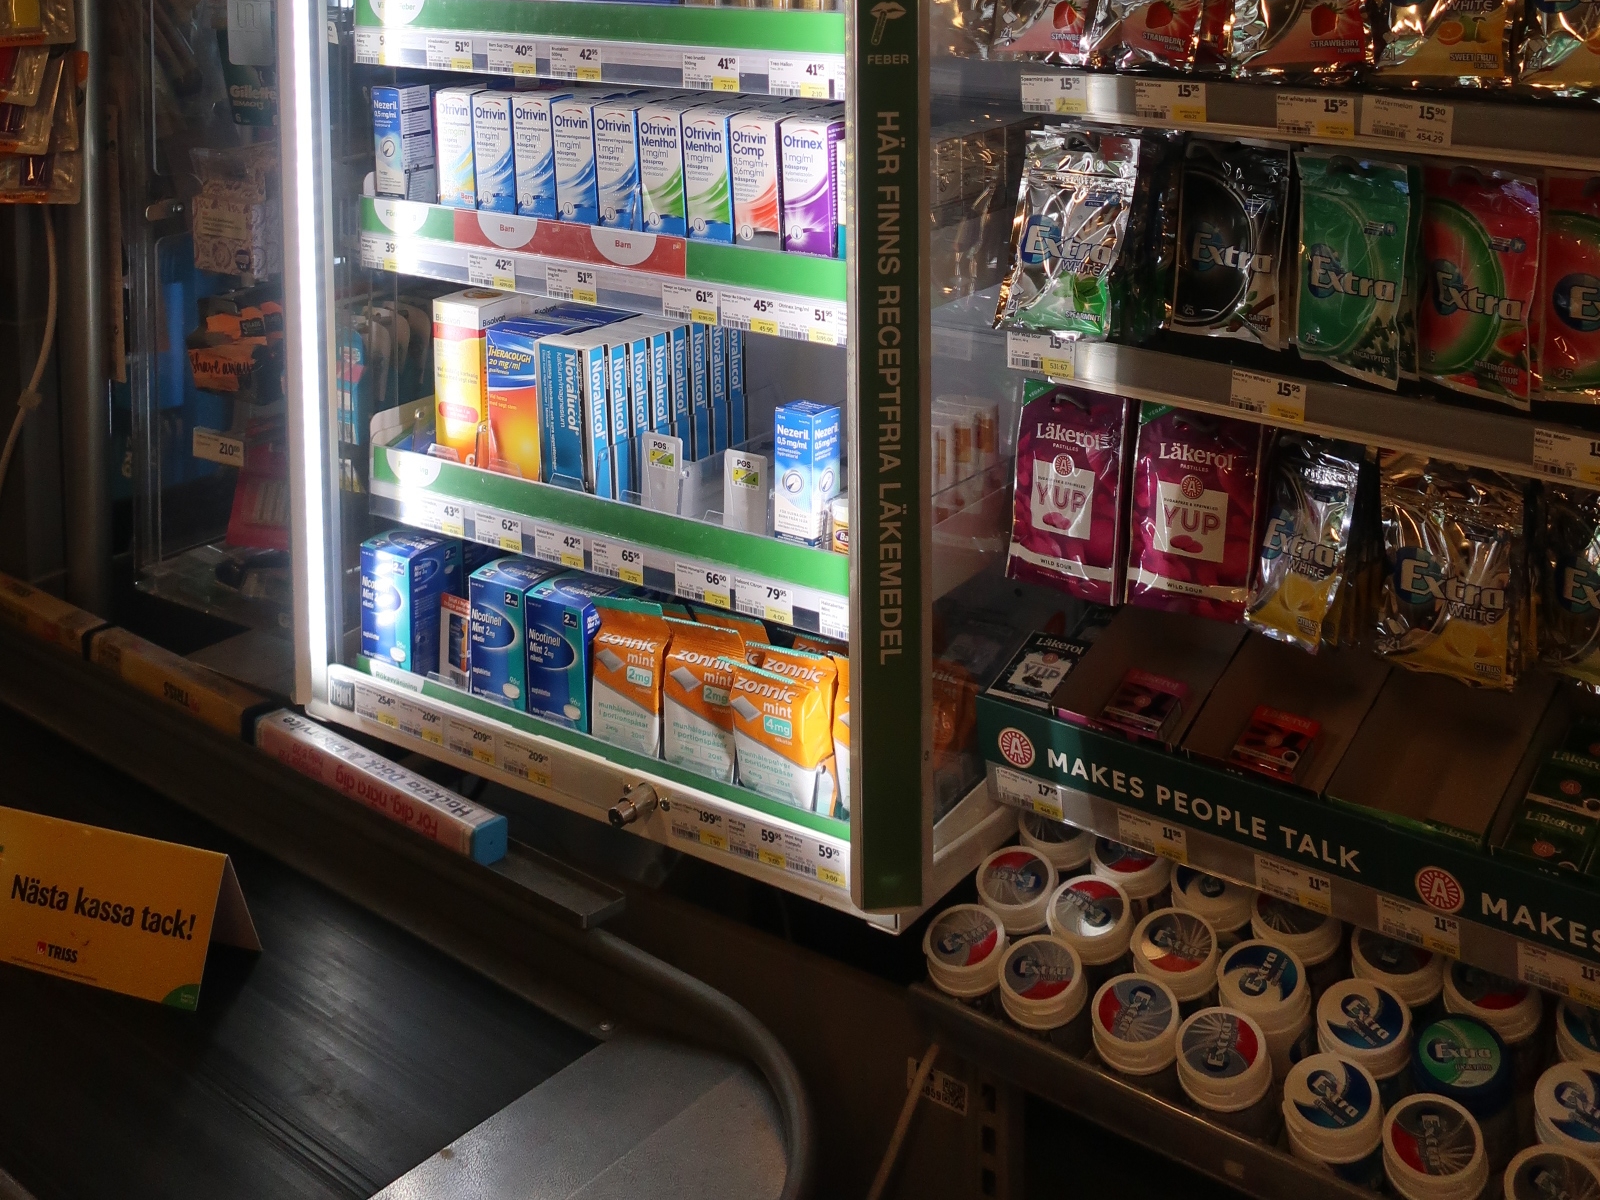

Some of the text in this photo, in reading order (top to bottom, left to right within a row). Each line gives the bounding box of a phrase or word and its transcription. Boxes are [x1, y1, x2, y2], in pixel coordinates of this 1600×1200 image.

[1141, 31, 1187, 46] STRAWBERRY
[1310, 39, 1360, 49] STRAWBERRY
[867, 54, 909, 65] FEBER
[1450, 53, 1499, 63] SWEET FRUIT
[229, 83, 278, 99] Gillette
[475, 105, 507, 121] Otrivin
[515, 106, 548, 122] Otrivin
[1374, 98, 1414, 111] Watermelon
[554, 115, 589, 130] Otrivin
[641, 135, 678, 149] Menthol
[685, 140, 723, 154] Menthol
[783, 134, 824, 150] Otrinex
[1416, 133, 1444, 144] 454.29
[732, 144, 765, 159] Comp
[499, 223, 515, 233] Barn
[1024, 224, 1112, 266] Extra
[1191, 231, 1273, 274] Extra
[1311, 255, 1397, 302] Extra
[1437, 270, 1523, 322] Extra
[1065, 310, 1101, 322] SPEARMINT
[488, 345, 532, 364] THERACOUGH
[488, 358, 522, 371] 20 mg/ml
[1049, 362, 1068, 372] 531:67
[1474, 359, 1519, 376] WATERMELON
[564, 353, 579, 436] Novalucol
[877, 110, 908, 666] HÄR FINNS RECEPTFRIA LÄKEMEDEL
[1036, 422, 1101, 451] Läkerol
[1052, 442, 1079, 453] PASTILLES
[1159, 442, 1234, 470] Läkerol
[1035, 481, 1087, 513] YUP
[1163, 504, 1222, 536] YUP
[1263, 518, 1336, 567] Extra
[1040, 557, 1073, 571] WILD SOUR
[1400, 557, 1505, 611] Extra
[471, 607, 502, 628] Nicotinell
[528, 627, 561, 647] Nicotinell
[598, 630, 659, 654] zonnic
[627, 651, 656, 668] mint
[675, 649, 735, 674] zonnic
[375, 670, 418, 692] Rökavvänjning
[734, 675, 799, 704] zonnic
[763, 700, 793, 719] mint
[365, 758, 402, 784] Däck
[335, 764, 440, 841] För dig, nära dig
[408, 779, 474, 818] Hacksta
[1047, 748, 1362, 874] MAKES PEOPLE TALK
[11, 873, 197, 942] Nästa kassa tack!
[47, 943, 79, 964] TRISS
[1018, 956, 1070, 978] Extra
[1434, 1042, 1493, 1060] Extra
